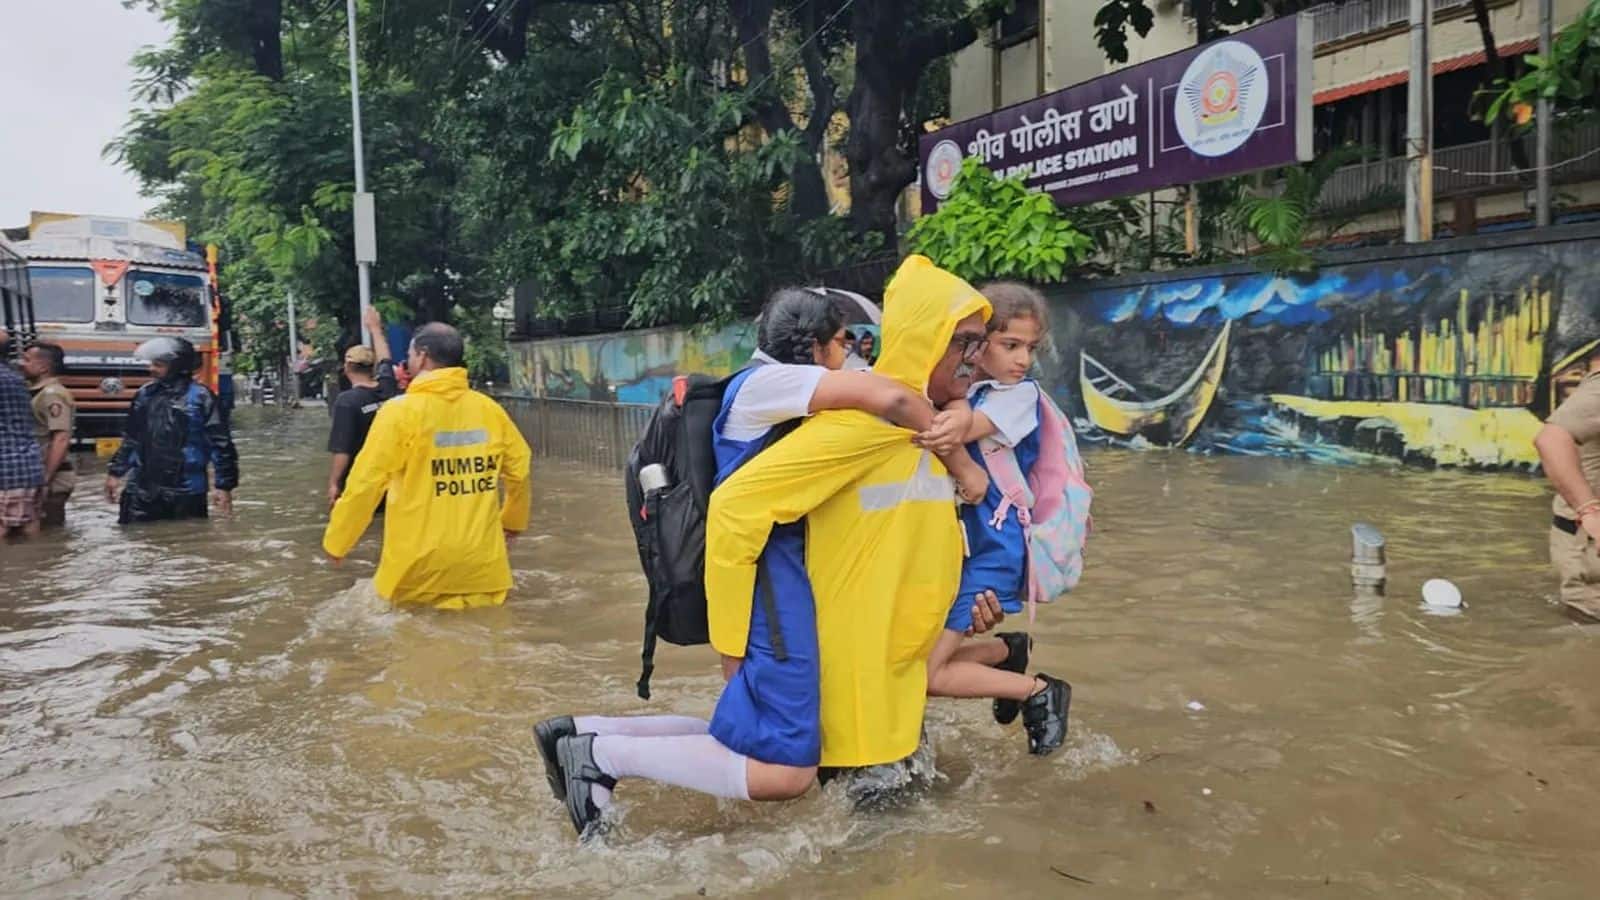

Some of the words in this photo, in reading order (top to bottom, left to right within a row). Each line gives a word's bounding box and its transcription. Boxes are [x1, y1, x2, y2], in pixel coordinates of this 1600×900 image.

[1010, 108, 1083, 153] पोलीस
[1088, 84, 1138, 132] ठाणे
[1064, 135, 1137, 170] STATION
[436, 476, 496, 496] POLICE
